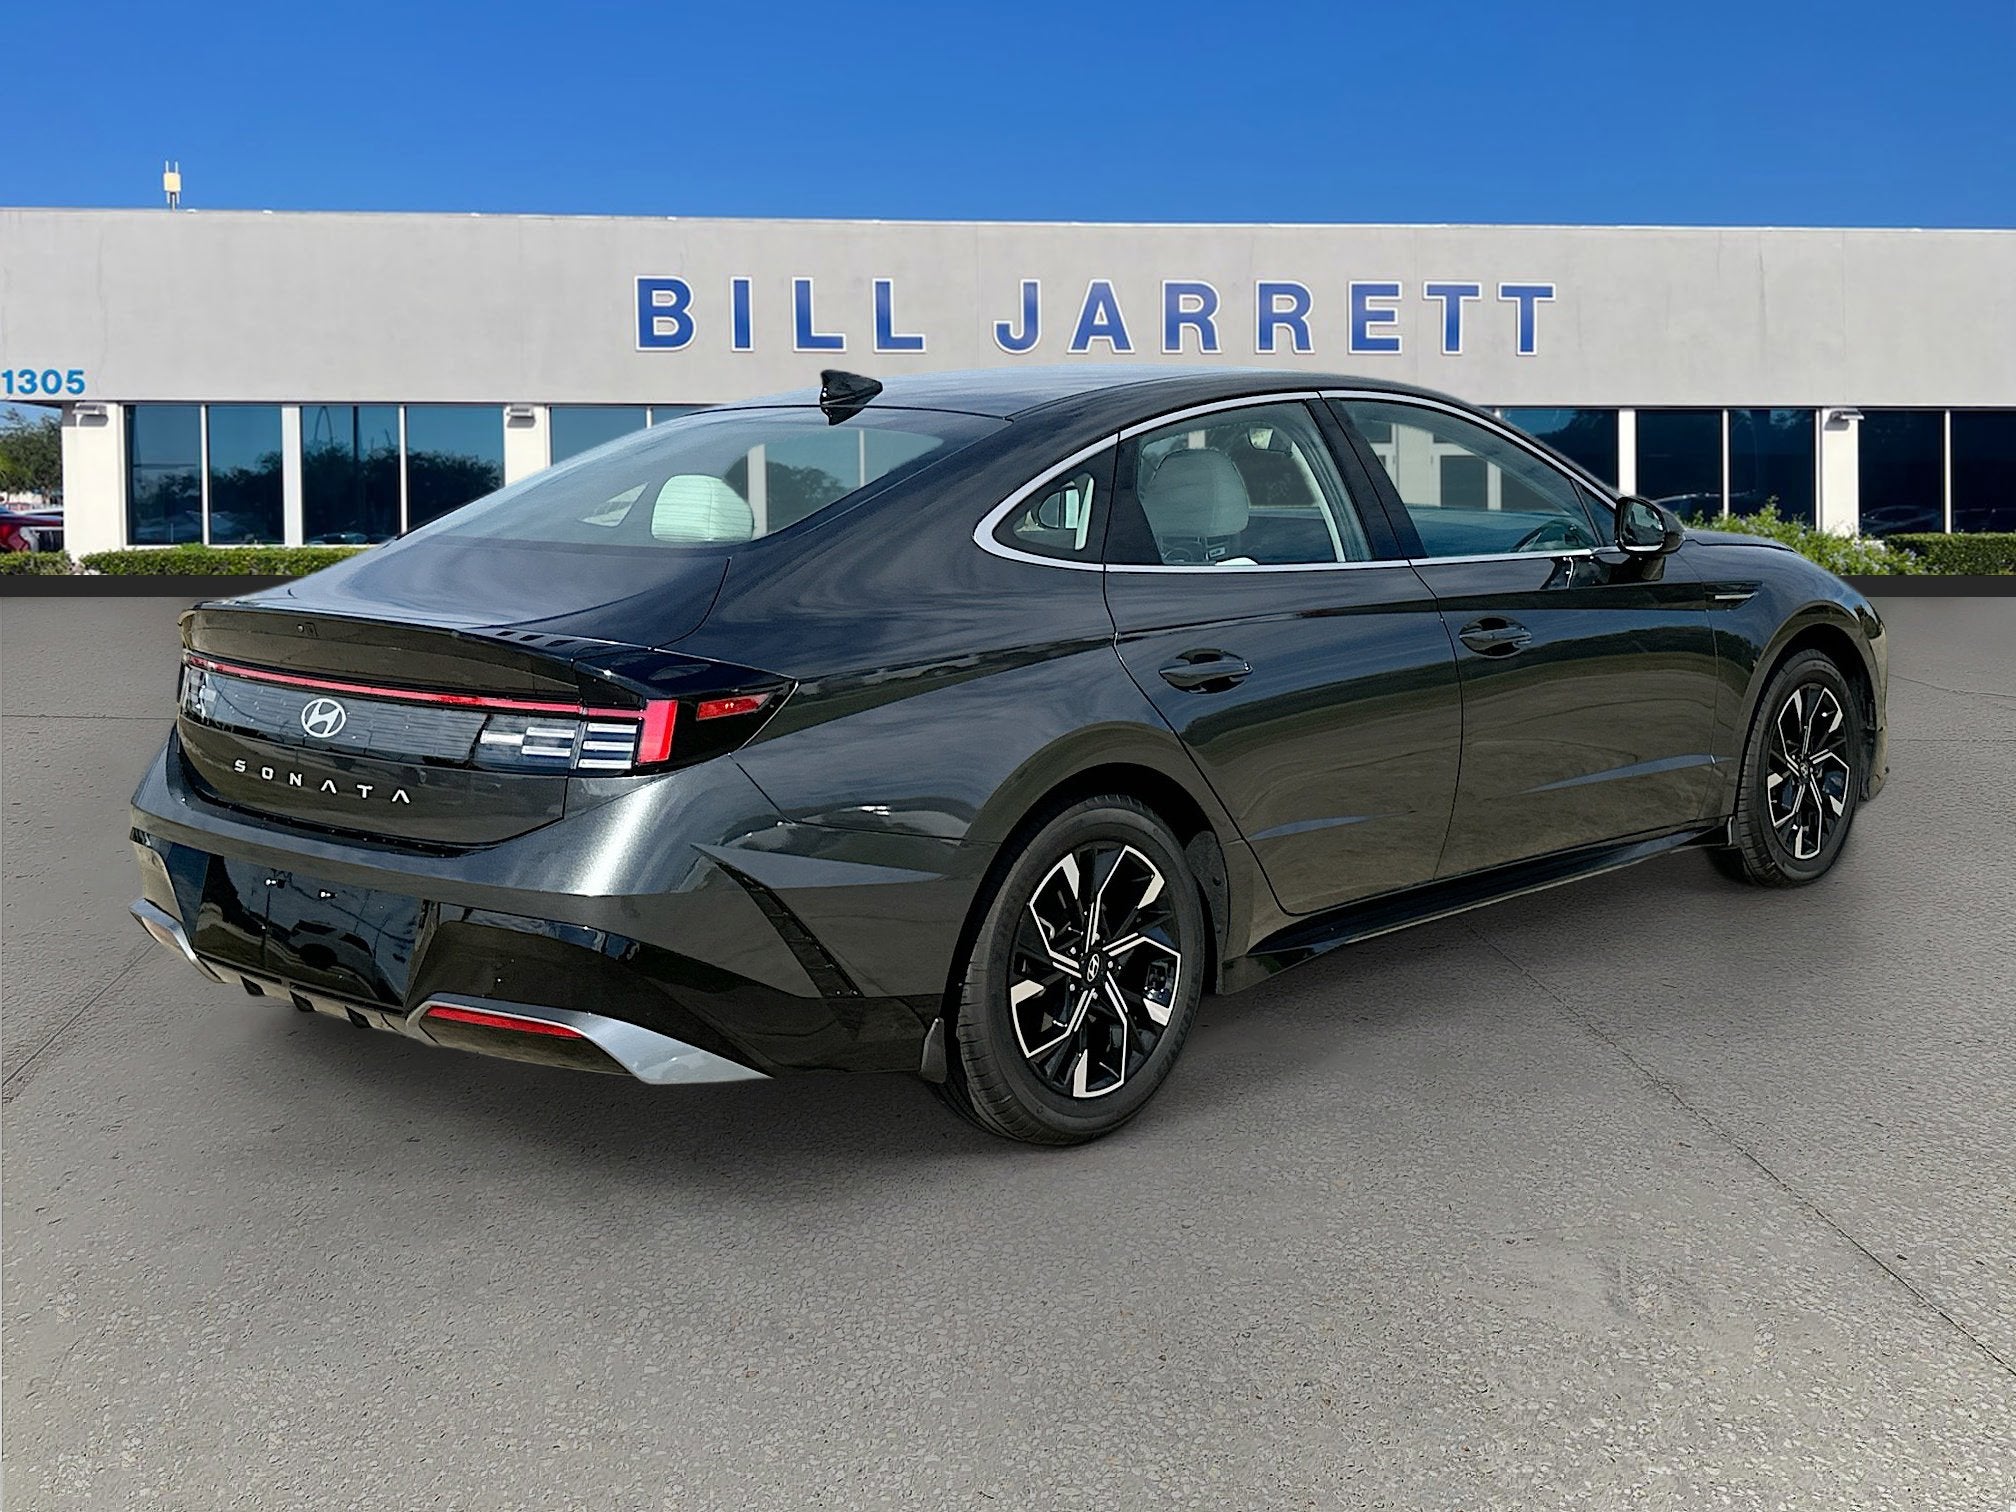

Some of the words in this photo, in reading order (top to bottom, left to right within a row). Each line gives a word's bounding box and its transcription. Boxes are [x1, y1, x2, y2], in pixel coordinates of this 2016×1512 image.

[634, 274, 926, 354] BILL
[993, 278, 1556, 357] JARRETT
[1, 368, 86, 395] 1305
[234, 759, 410, 804] SONATA
